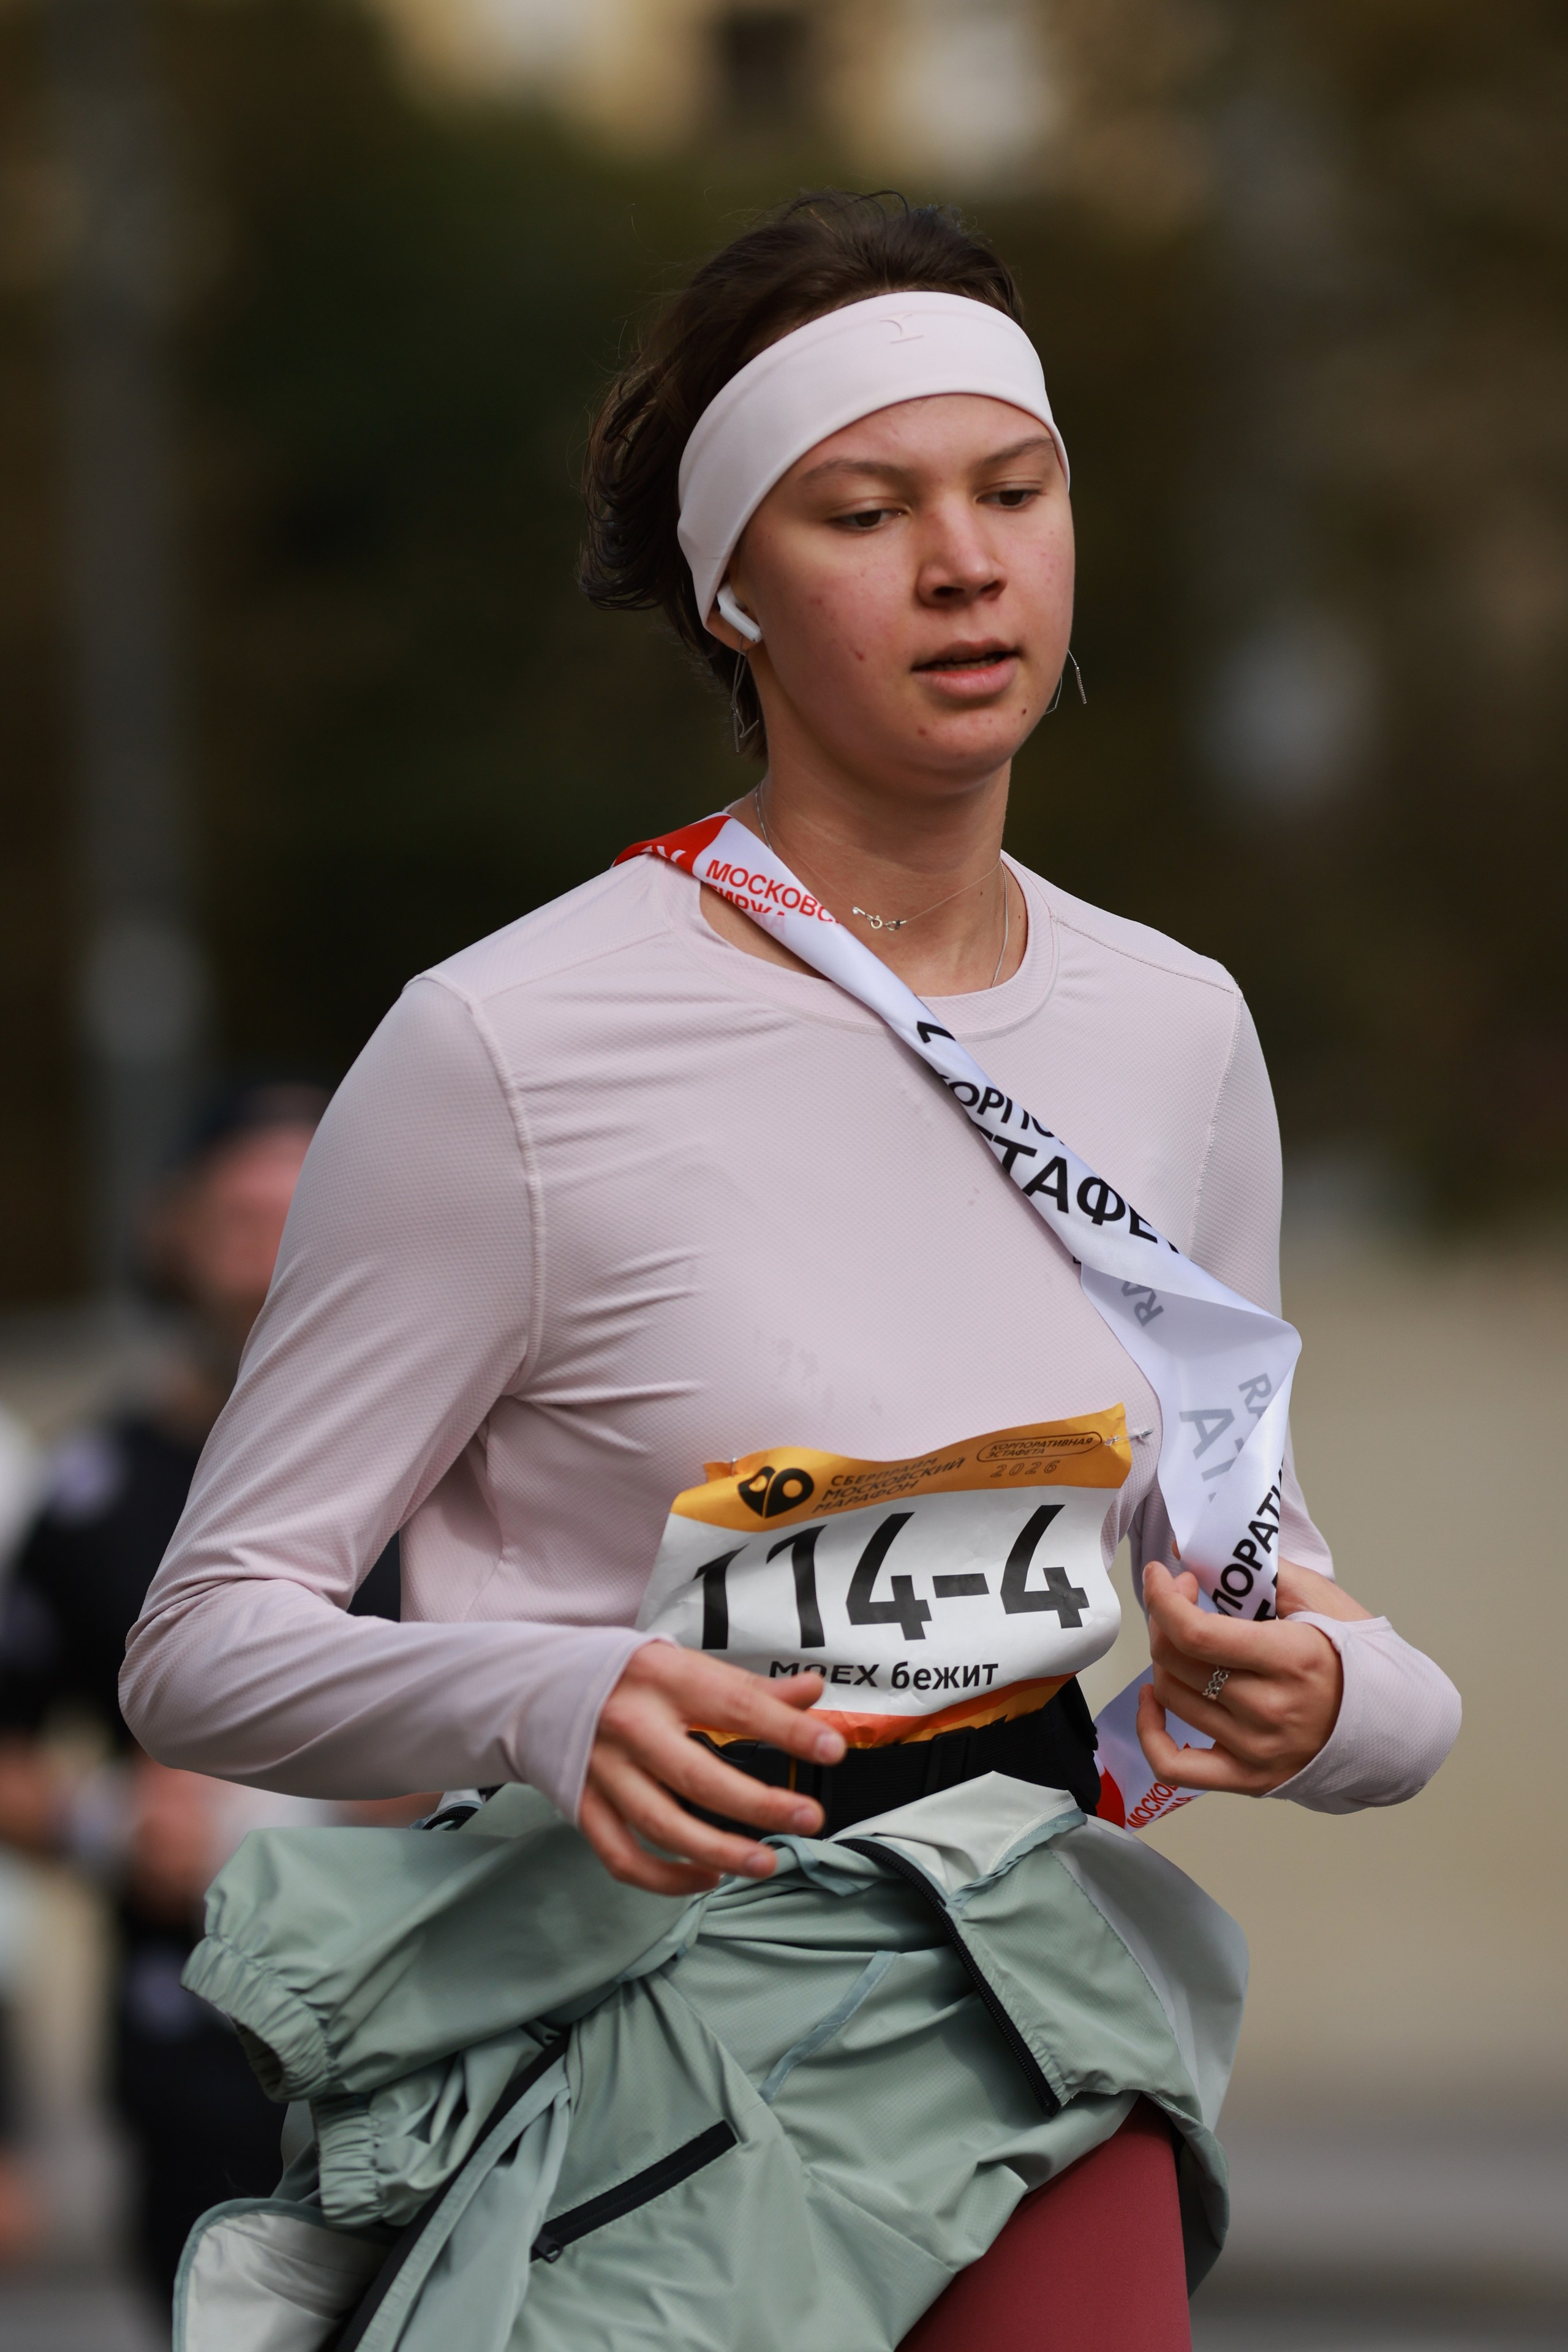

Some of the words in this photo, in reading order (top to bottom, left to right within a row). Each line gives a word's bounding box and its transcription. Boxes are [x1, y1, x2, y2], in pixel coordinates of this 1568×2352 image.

[705, 859, 840, 924] МОСКОВС
[985, 1448, 1045, 1459] ЭСТАФЕТА
[991, 1437, 1093, 1451] КОРПОРАТИВНАЯ
[822, 1457, 966, 1501] МОСКОВСКИЙ
[831, 1457, 938, 1487] СБЕРПРАЙМ
[990, 1460, 1060, 1478] 2026
[812, 1479, 919, 1514] МАРАФОН
[692, 1504, 1090, 1650] 114-4
[891, 1660, 999, 1691] бежит
[1126, 1782, 1179, 1828] МОСКО
